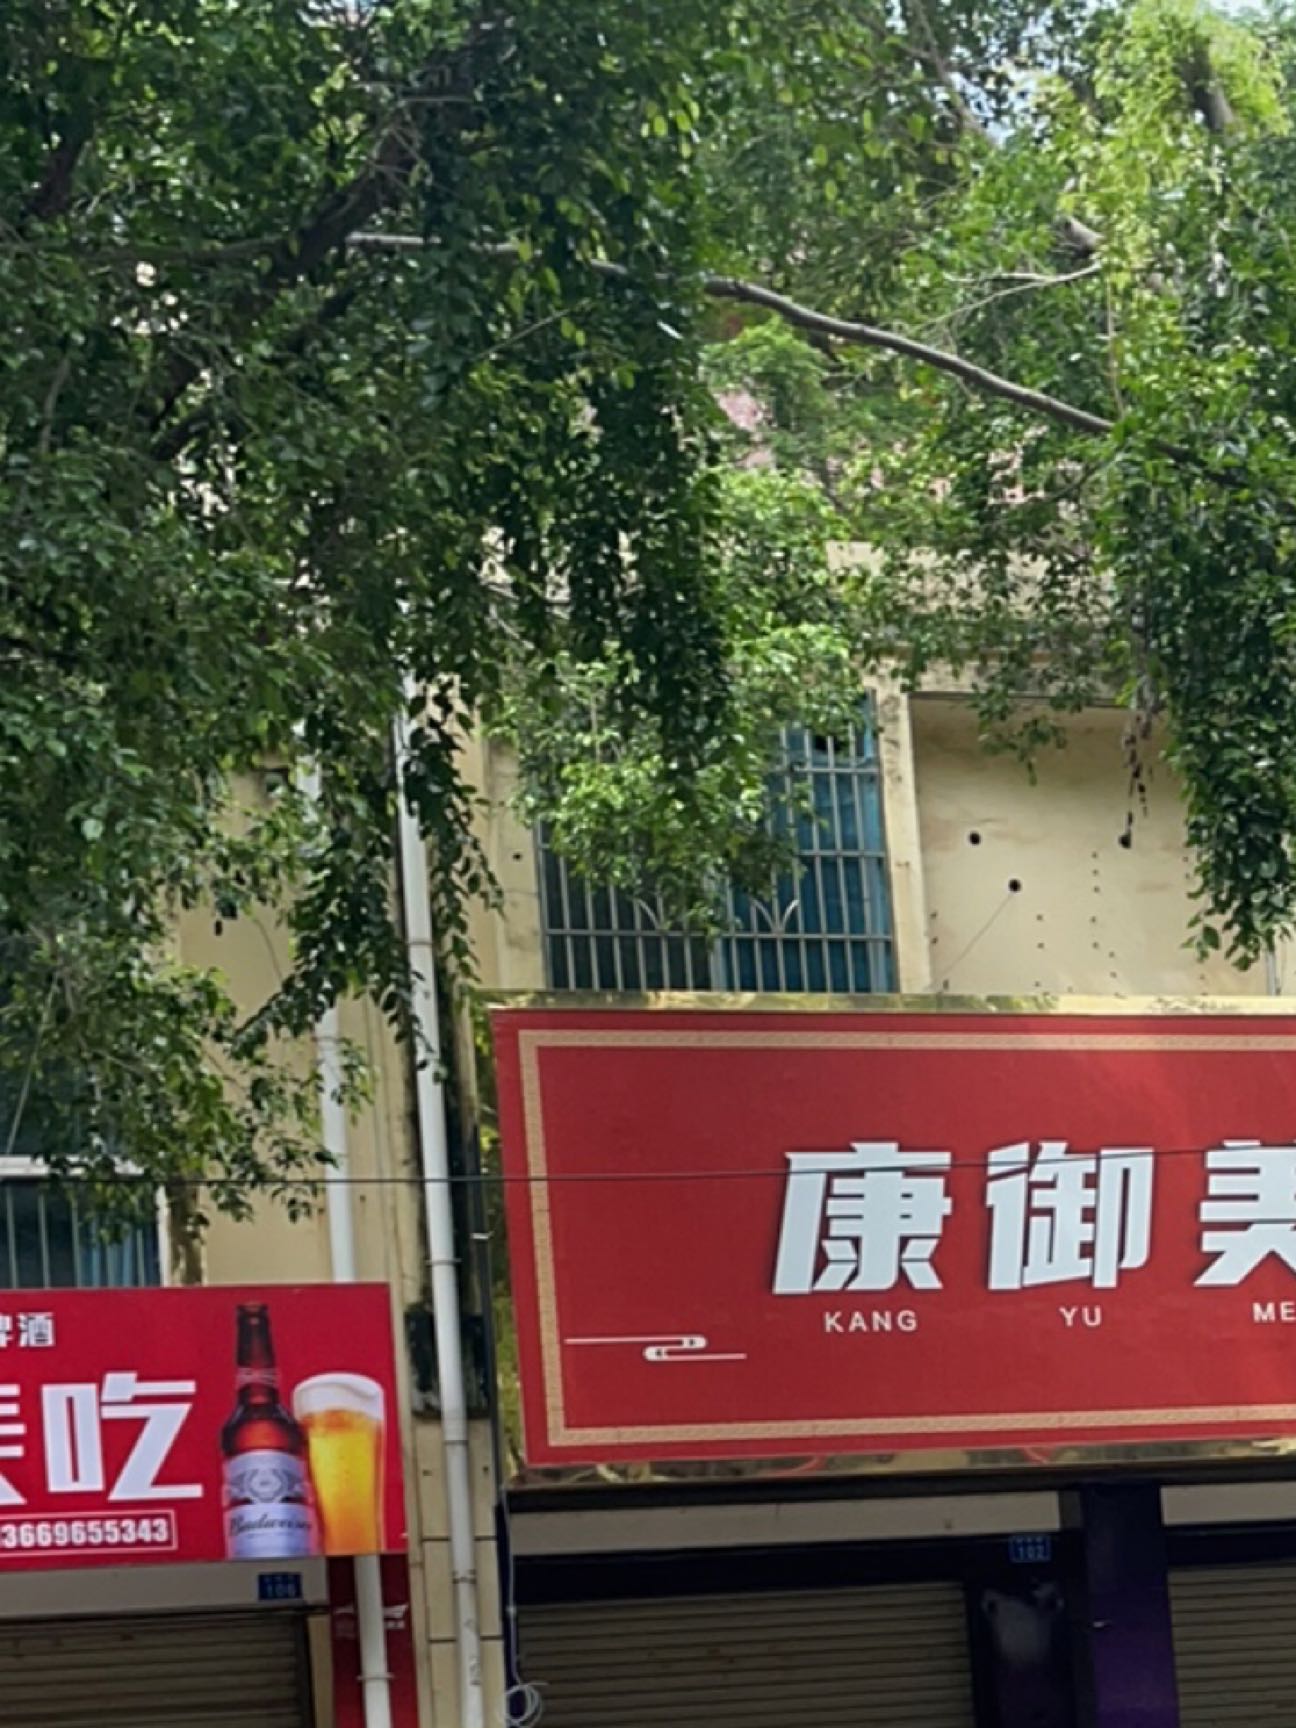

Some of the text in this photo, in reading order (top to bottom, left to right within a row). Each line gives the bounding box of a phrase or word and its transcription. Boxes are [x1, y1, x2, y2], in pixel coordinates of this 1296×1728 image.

[824, 1309, 918, 1334] KANG
[1059, 1306, 1103, 1328] YU
[0, 1518, 169, 1549] 3669655343
